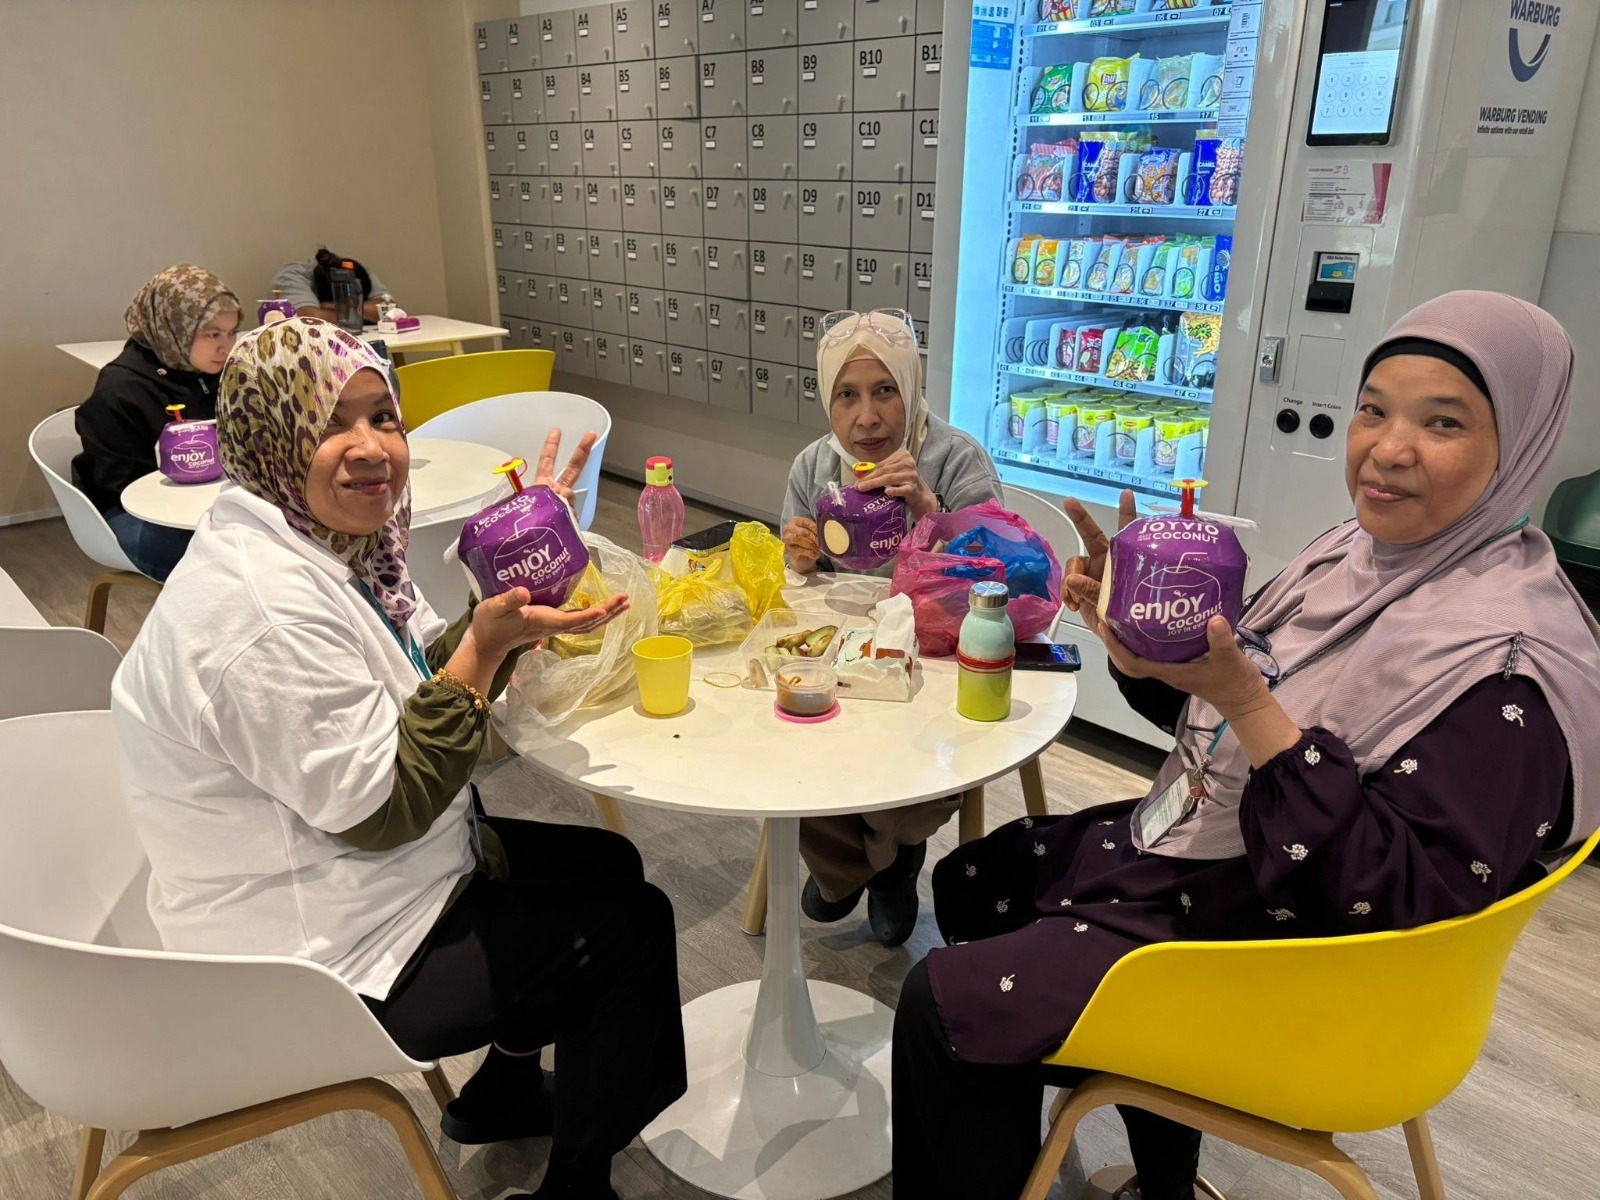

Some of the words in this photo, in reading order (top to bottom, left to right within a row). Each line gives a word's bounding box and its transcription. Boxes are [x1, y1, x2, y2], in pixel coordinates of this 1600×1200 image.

[616, 8, 627, 21] A5
[658, 3, 670, 17] A6
[1510, 0, 1561, 27] WARBURG
[543, 19, 552, 31] A3
[578, 14, 588, 26] A4
[478, 28, 486, 39] A1
[509, 24, 518, 36] A2
[803, 55, 817, 70] B9
[859, 50, 882, 65] B10
[703, 63, 715, 76] B7
[752, 60, 764, 73] B8
[581, 73, 591, 85] B4
[619, 70, 629, 82] B5
[659, 67, 670, 80] B6
[482, 81, 490, 92] B1
[513, 79, 521, 90] B2
[546, 76, 555, 87] B3
[1480, 106, 1516, 122] WARBURG
[1517, 109, 1547, 124] VENDING
[622, 128, 631, 140] C5
[662, 127, 673, 140] C6
[705, 126, 716, 138] C7
[752, 124, 764, 138] C8
[803, 123, 816, 136] C9
[859, 121, 880, 136] C10
[487, 132, 495, 142] C1
[517, 131, 526, 142] C2
[550, 130, 558, 142] C3
[585, 129, 594, 141] C4
[491, 182, 499, 192] D1
[521, 182, 530, 192] D2
[553, 182, 562, 193] D3
[588, 183, 598, 194] D4
[624, 184, 635, 196] D5
[664, 186, 675, 198] D6
[706, 187, 719, 199] D7
[753, 188, 766, 201] D8
[803, 189, 817, 202] D9
[857, 191, 880, 205] D10
[495, 229, 502, 240] E1
[525, 231, 532, 242] E2
[556, 234, 564, 244] E3
[590, 236, 599, 247] E4
[627, 239, 636, 251] E5
[666, 243, 676, 255] E6
[708, 246, 718, 258] E7
[754, 250, 765, 263] E8
[803, 254, 814, 267] E9
[857, 259, 876, 273] E10
[528, 279, 535, 290] F2
[560, 283, 568, 294] F3
[594, 288, 602, 299] F4
[630, 293, 639, 305] F5
[668, 298, 678, 310] F6
[710, 304, 719, 317] F7
[755, 310, 765, 323] F8
[803, 316, 814, 330] F9
[532, 326, 541, 338] G2
[564, 332, 573, 343] G3
[597, 338, 606, 349] G4
[633, 344, 643, 356] G5
[671, 352, 682, 364] G6
[712, 360, 722, 372] G7
[756, 367, 768, 381] G8
[804, 376, 817, 390] G9
[1283, 397, 1303, 405] Change
[188, 458, 214, 466] coconut
[1138, 521, 1219, 535] JOYVIO
[1152, 532, 1218, 543] COCONUT
[531, 547, 569, 580] coconut
[1167, 601, 1223, 631] coconut
